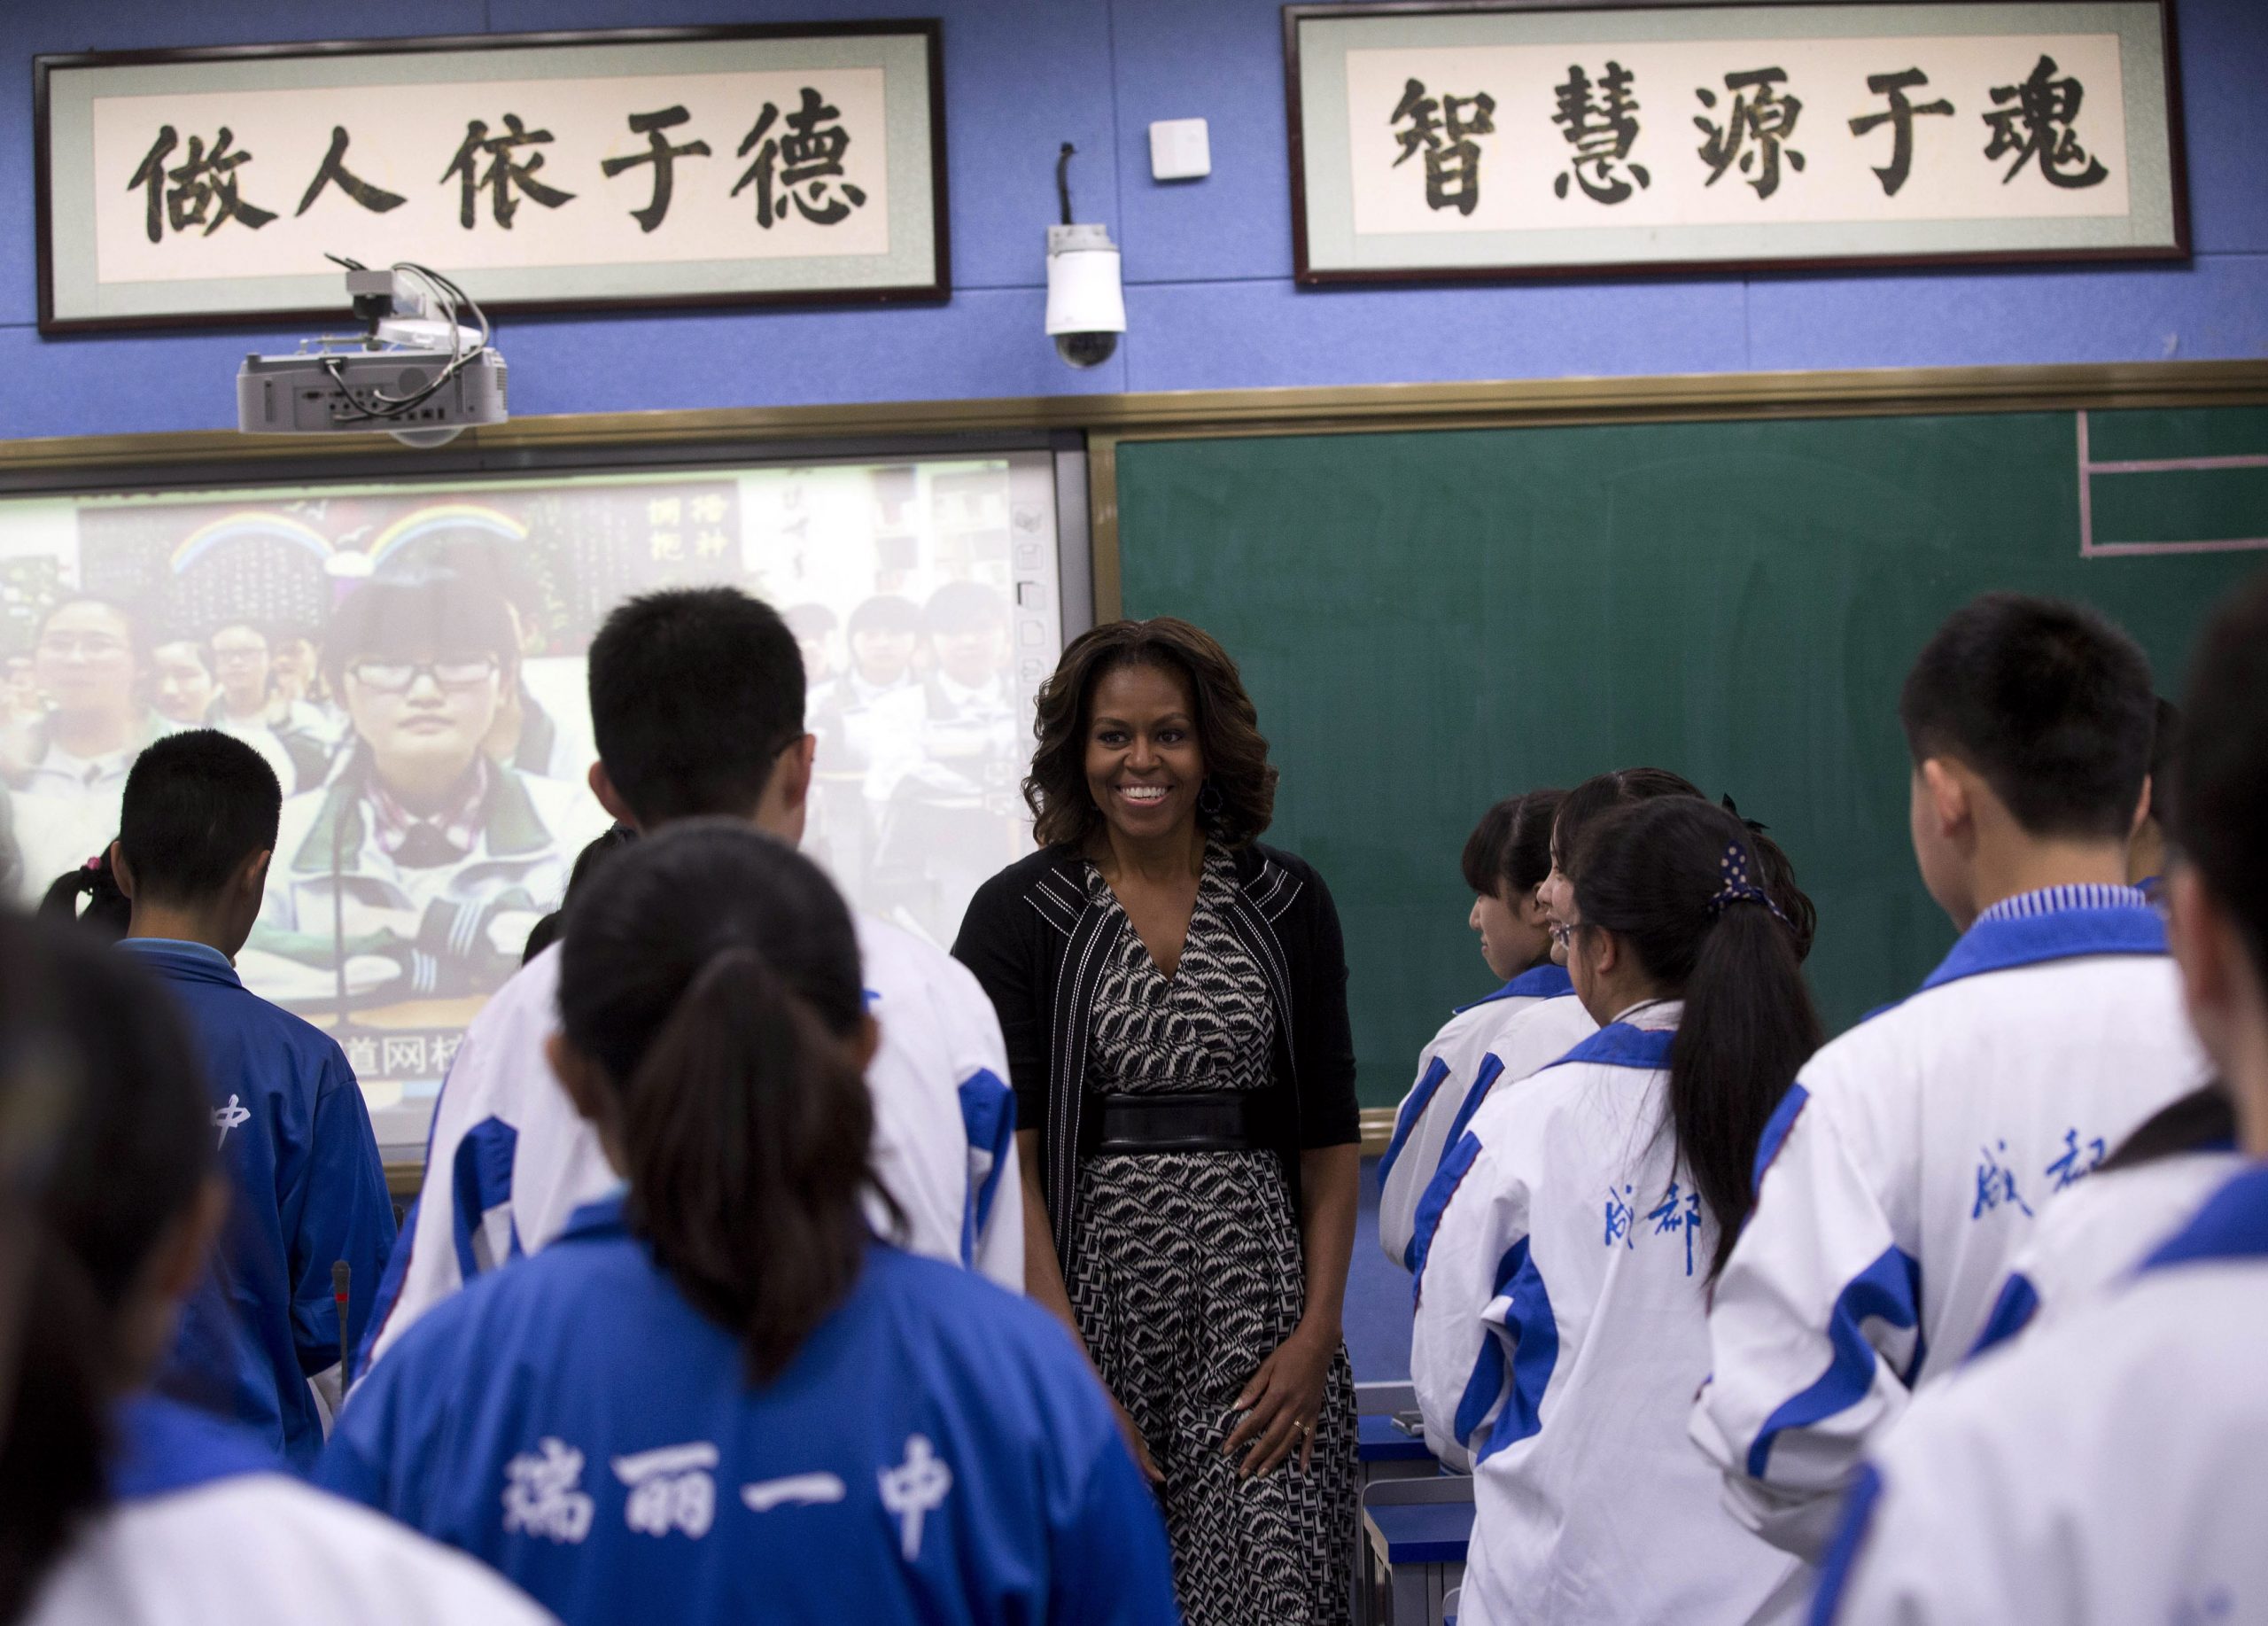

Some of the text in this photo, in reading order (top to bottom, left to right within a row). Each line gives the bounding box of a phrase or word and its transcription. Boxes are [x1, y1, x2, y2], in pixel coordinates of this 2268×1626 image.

[127, 86, 867, 244] 做人依于德
[1388, 53, 2110, 216] 智慧源于魂
[210, 1093, 252, 1152] 中
[1604, 1182, 1702, 1277] 成都
[501, 1434, 953, 1562] 瑞丽一中
